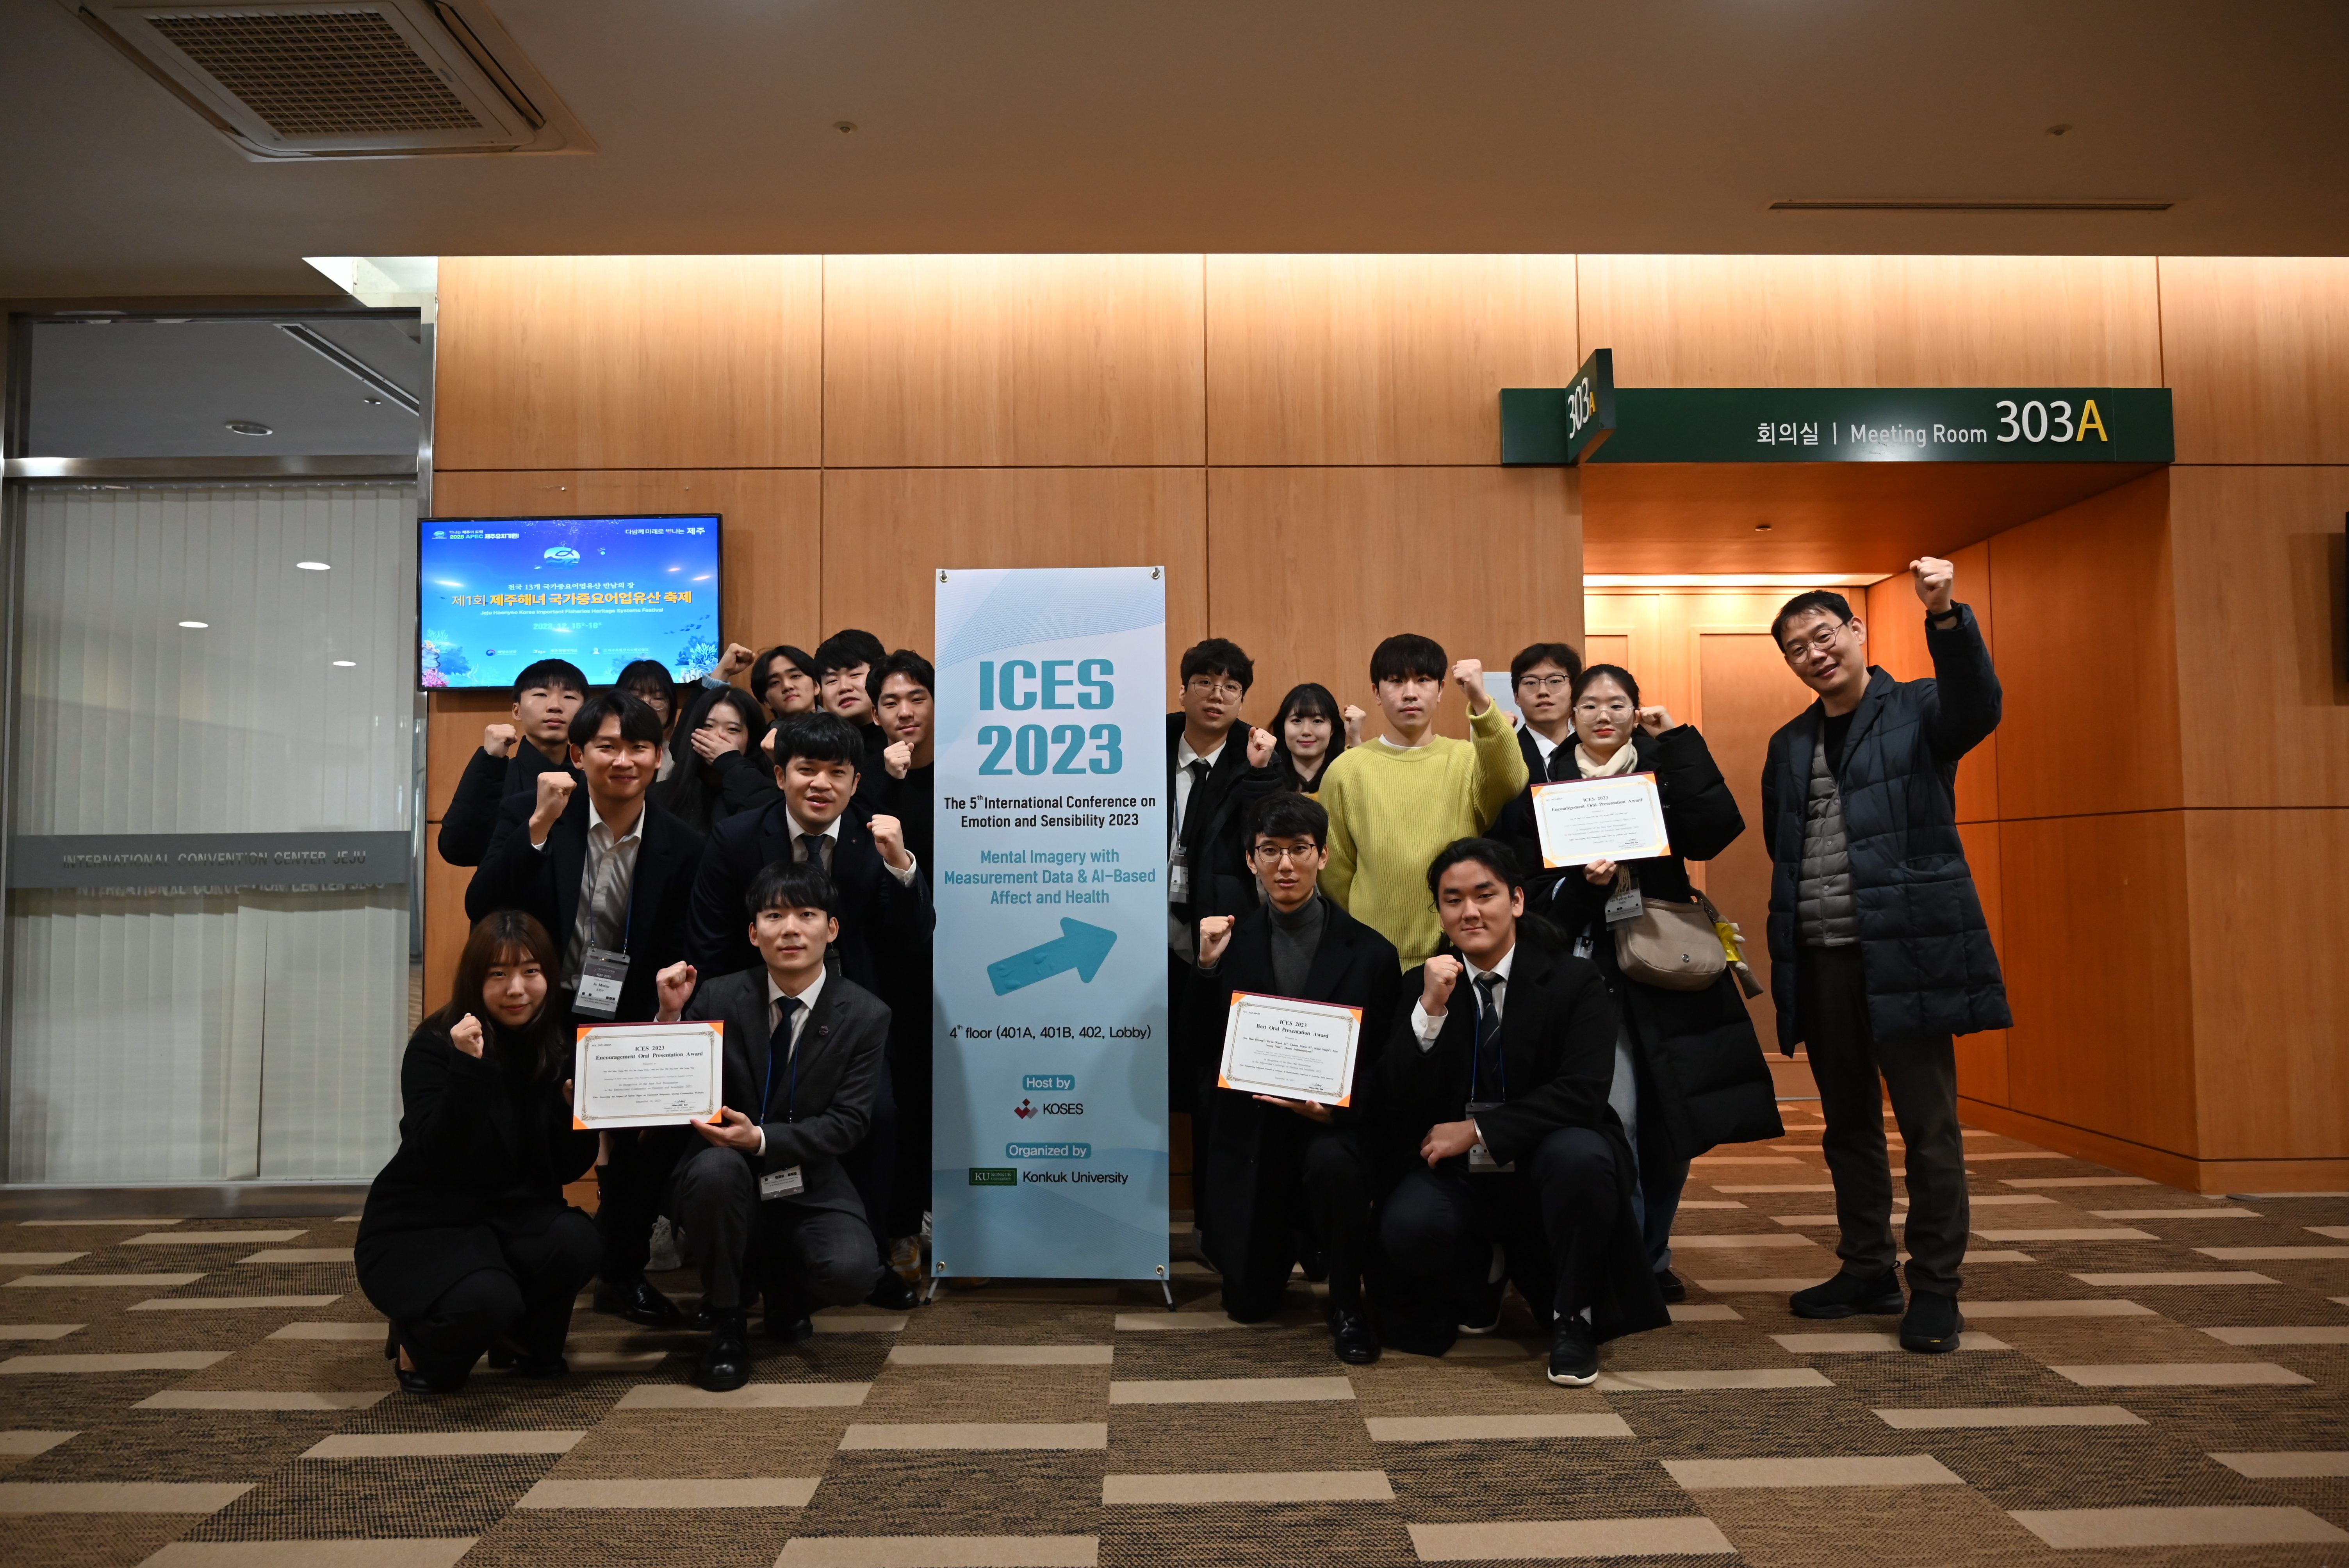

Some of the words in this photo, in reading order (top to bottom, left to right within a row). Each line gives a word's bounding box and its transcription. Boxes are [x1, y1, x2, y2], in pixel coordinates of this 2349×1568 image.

[1568, 377, 1596, 439] 303A
[1757, 422, 1820, 445] 회의실
[1851, 423, 1926, 448] Meeting
[1933, 424, 1987, 443] Room
[1996, 400, 2108, 443] 303A
[451, 595, 486, 607] 제1회
[490, 593, 546, 606] 제주해녀
[548, 592, 661, 605] 국가중요어업유산
[664, 591, 692, 604] 축제
[979, 659, 1114, 711] ICES
[977, 723, 1122, 776] 2023
[944, 797, 966, 810] The
[970, 794, 983, 810] 5th
[985, 796, 1062, 809] International
[1066, 795, 1137, 808] Conference
[1141, 797, 1155, 807] on
[961, 816, 1011, 828] Emotion
[1015, 815, 1037, 827] and
[1041, 814, 1105, 828] Sensibility
[1109, 814, 1139, 826] 2023
[63, 854, 168, 868] INTERNATIONAL
[178, 852, 267, 866] CONVENTION
[274, 851, 326, 866] CENTER
[333, 851, 366, 865] JEJU
[980, 850, 1026, 864] Mental
[1030, 849, 1086, 867] Imagery
[1090, 849, 1119, 863] with
[945, 871, 1037, 885] Measurement
[1042, 870, 1073, 884] Data
[1078, 870, 1087, 883] &
[991, 891, 1032, 904] Affect
[1036, 890, 1061, 904] and
[1066, 889, 1109, 903] Health
[950, 1024, 963, 1038] 4th
[966, 1027, 992, 1038] floor
[996, 1026, 1036, 1041] (401A,
[1040, 1026, 1075, 1040] 401B,
[1079, 1026, 1105, 1039] 402,
[1109, 1025, 1151, 1040] Lobby)
[1282, 1027, 1310, 1035] Presentation
[1027, 1078, 1052, 1089] Host
[1056, 1078, 1070, 1091] by
[1043, 1103, 1083, 1115] KOSES
[1009, 1145, 1069, 1158] Organized
[1073, 1145, 1087, 1158] by
[975, 1172, 990, 1181] KU
[1023, 1171, 1067, 1183] Konkuk
[1072, 1171, 1128, 1185] University
